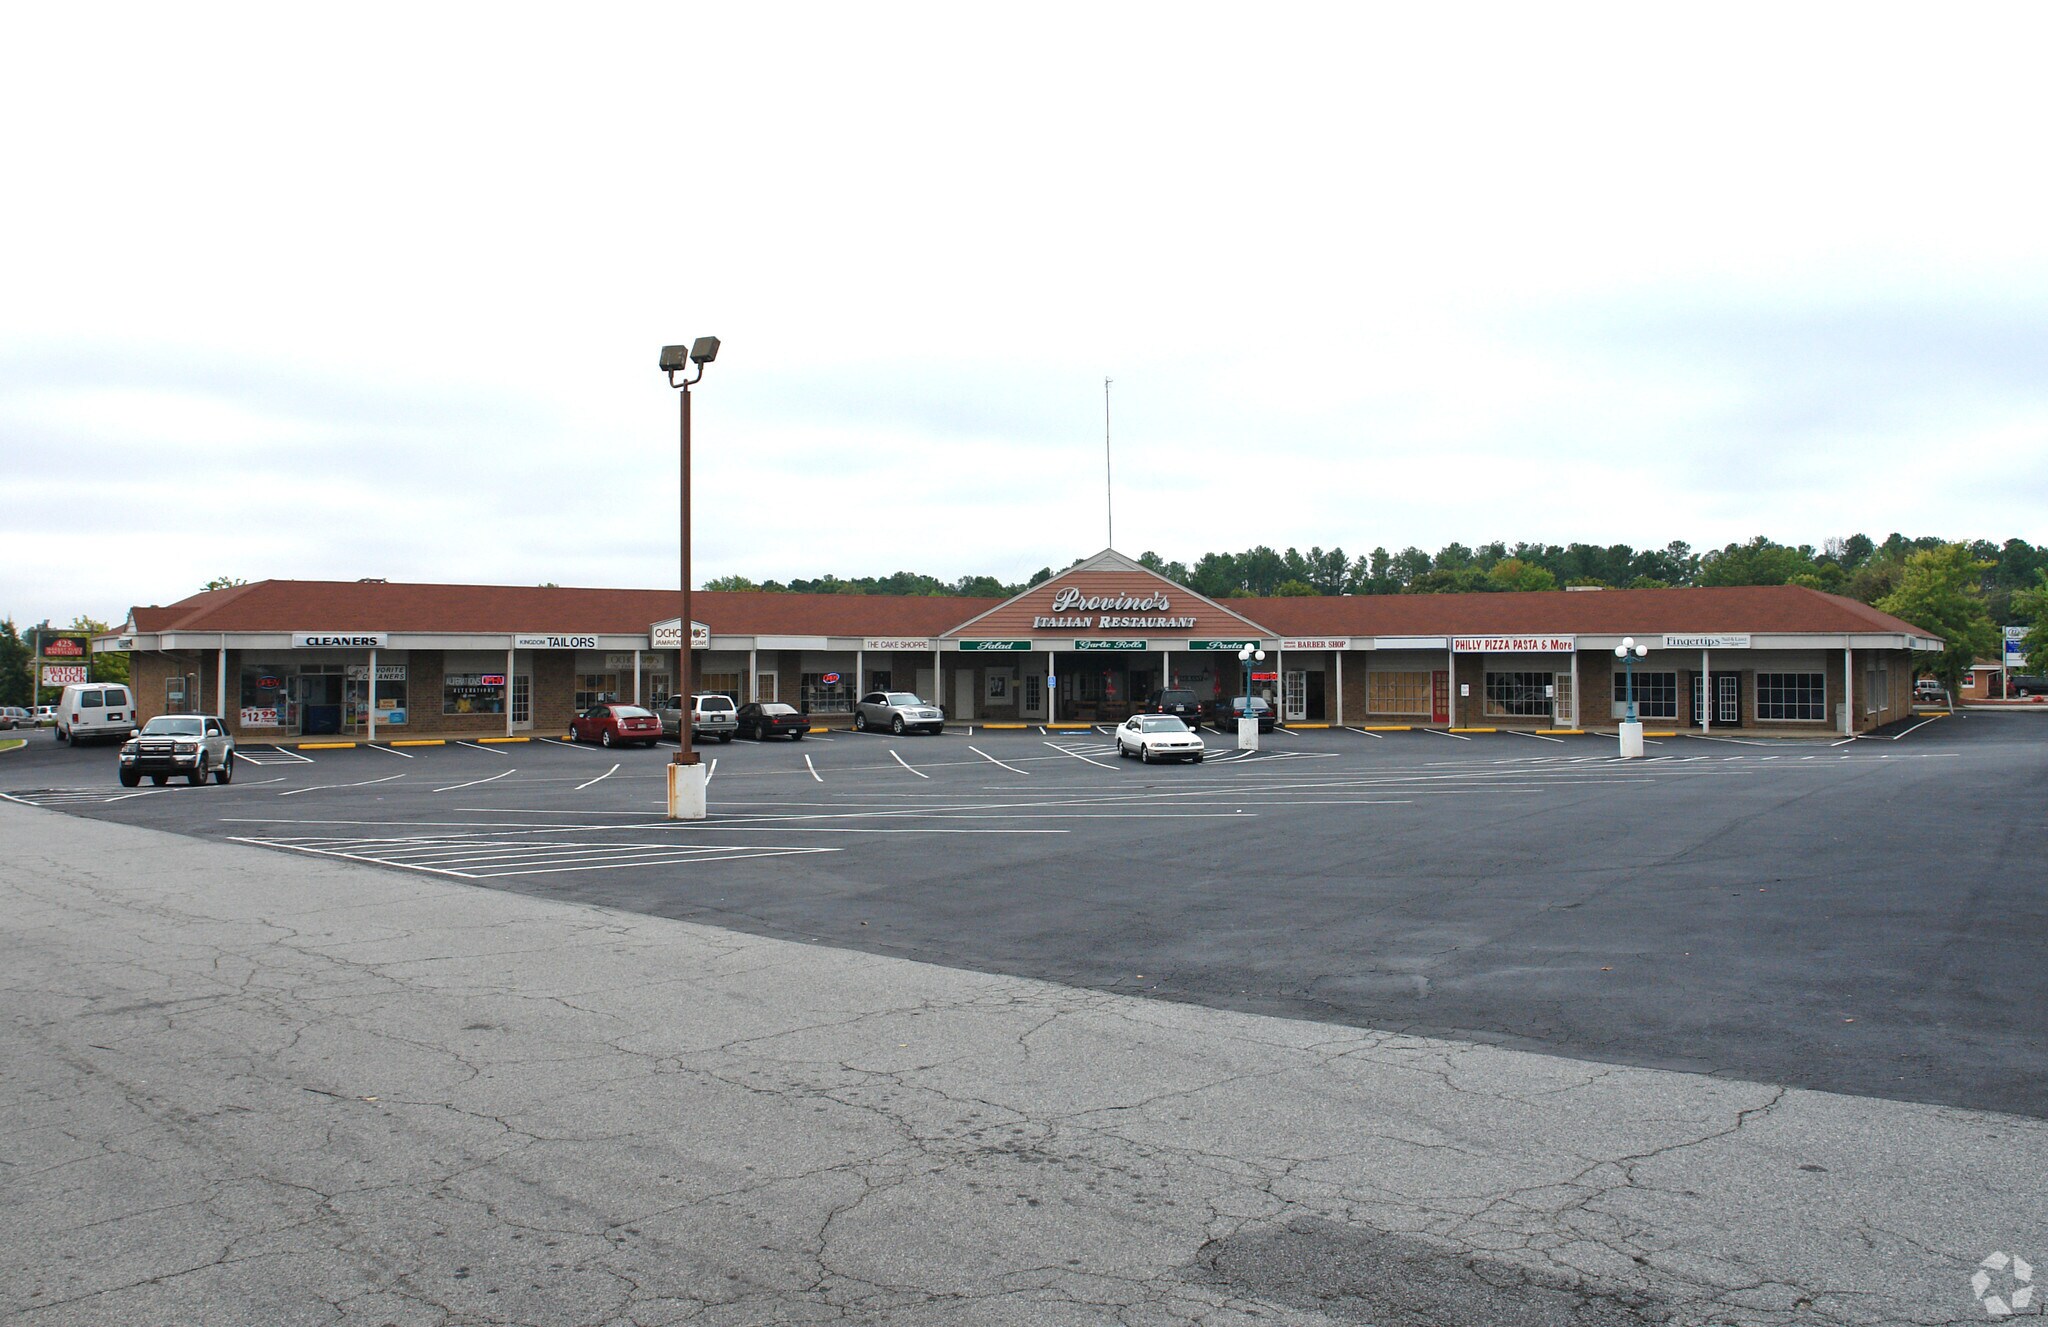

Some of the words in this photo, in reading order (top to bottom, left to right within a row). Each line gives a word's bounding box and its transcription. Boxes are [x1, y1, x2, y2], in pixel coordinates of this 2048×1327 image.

[1052, 587, 1170, 612] Provino's
[1033, 617, 1093, 628] ITALIAN
[1098, 616, 1197, 628] RESTAURANT
[306, 637, 378, 646] CLEANERS
[547, 637, 595, 648] TAILORS
[977, 641, 1014, 650] Salad
[1079, 640, 1111, 650] Garlic
[1206, 641, 1243, 650] Pasta
[1455, 640, 1481, 650] PHILLY
[1485, 640, 1510, 650] PIZZA
[1513, 640, 1538, 650] PASTA
[1541, 640, 1547, 650] &
[1550, 640, 1572, 650] More
[1667, 637, 1720, 646] Fingertips
